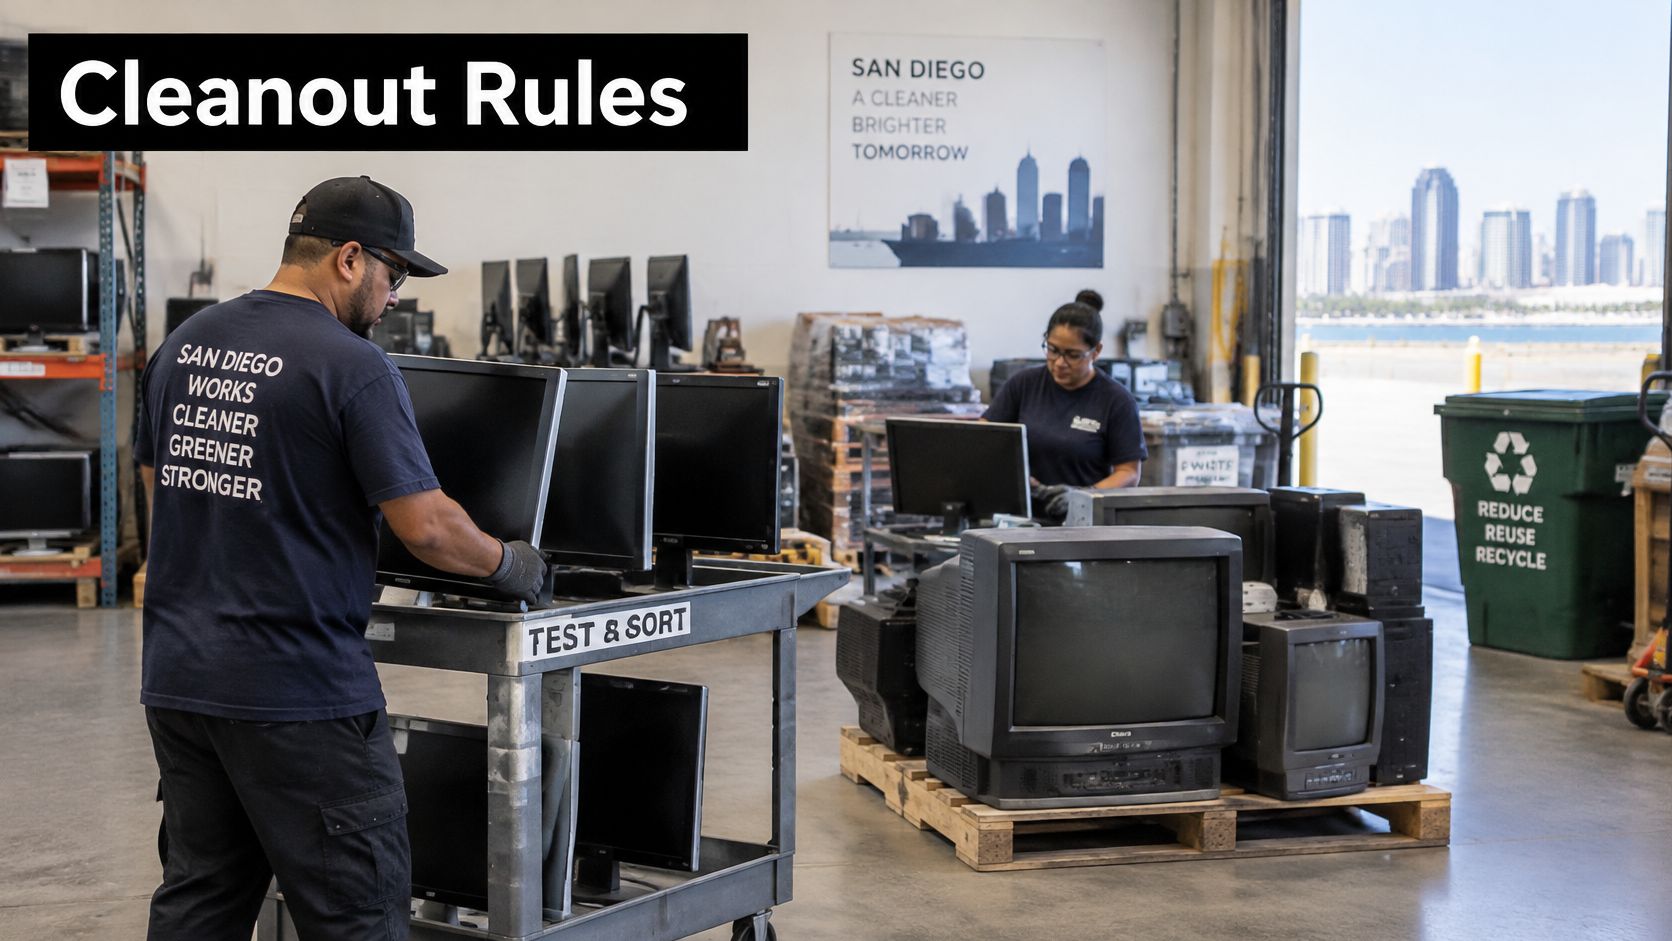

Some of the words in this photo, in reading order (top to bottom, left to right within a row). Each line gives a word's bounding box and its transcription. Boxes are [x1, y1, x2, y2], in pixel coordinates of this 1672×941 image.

[853, 58, 900, 78] SAN
[911, 60, 984, 80] DIEGO
[853, 90, 865, 106] A
[872, 90, 957, 107] CLEANER
[853, 116, 946, 134] BRIGHTER
[853, 144, 968, 161] TOMORROW
[177, 344, 222, 369] SAN
[221, 350, 283, 378] DIEGO
[189, 374, 257, 404] WORKS
[173, 404, 259, 438] CLEANER
[169, 434, 254, 468] GREENER
[161, 465, 262, 501] STRONGER
[1478, 501, 1544, 524] REDUCE
[1486, 524, 1536, 546] REUSE
[1476, 547, 1547, 570] RECYCLE
[529, 622, 595, 656] TEST
[604, 620, 620, 644] &
[626, 608, 687, 640] SORT
